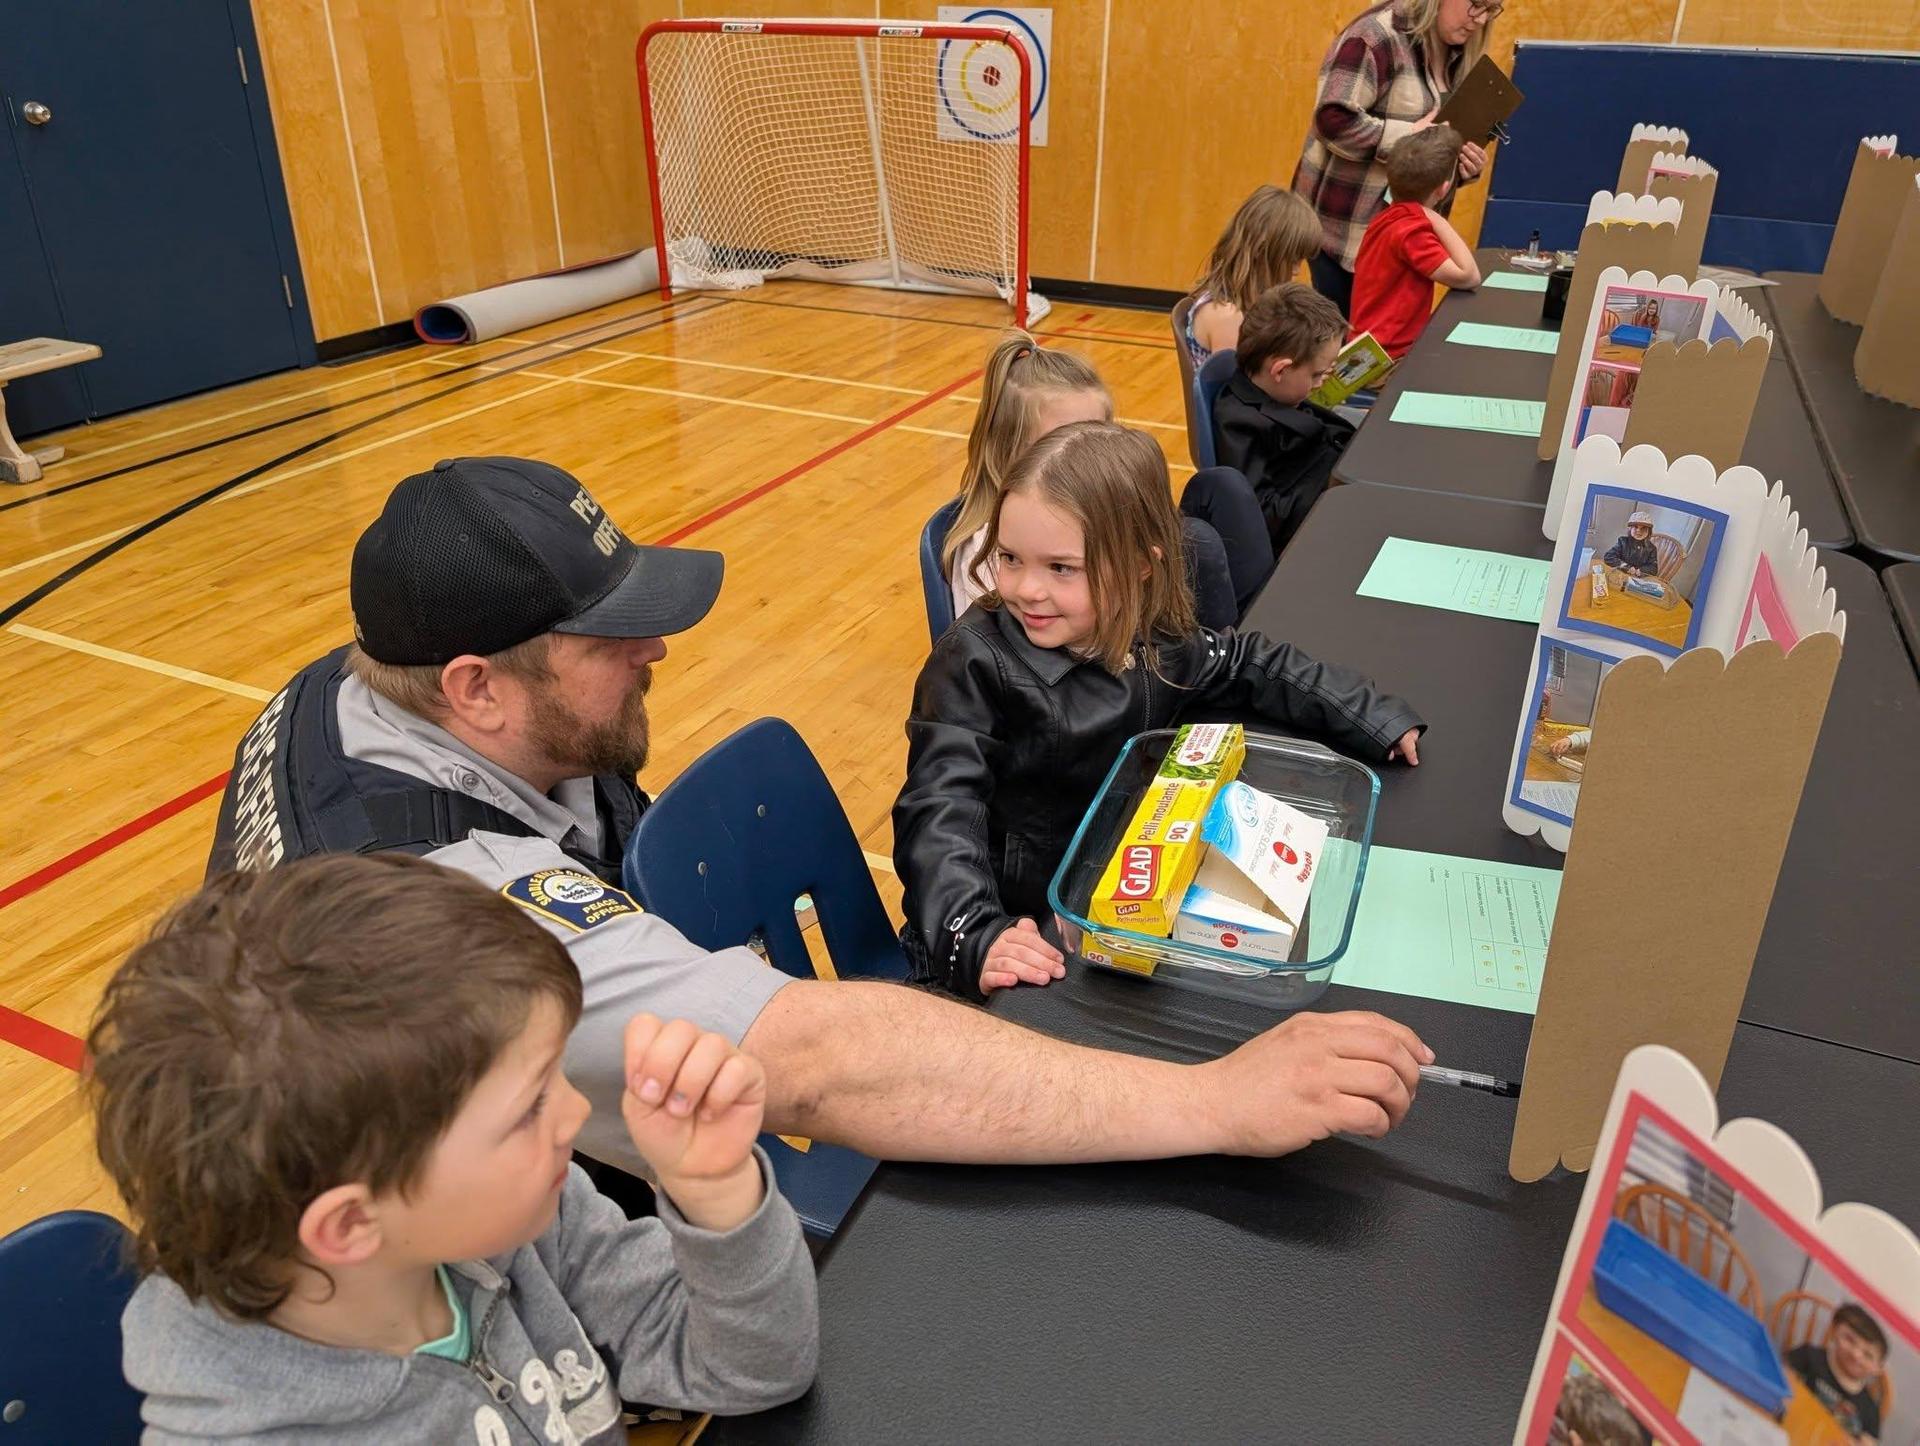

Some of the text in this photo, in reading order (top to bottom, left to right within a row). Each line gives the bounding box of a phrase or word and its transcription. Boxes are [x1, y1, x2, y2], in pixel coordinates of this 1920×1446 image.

[570, 486, 600, 525] PE
[593, 514, 621, 556] OFF
[1169, 827, 1189, 840] 90
[1119, 846, 1153, 897] GLAD
[1297, 851, 1313, 883] ROGERS
[582, 898, 618, 913] PEACE
[586, 905, 630, 924] OFFICER
[1117, 904, 1140, 914] GLAD
